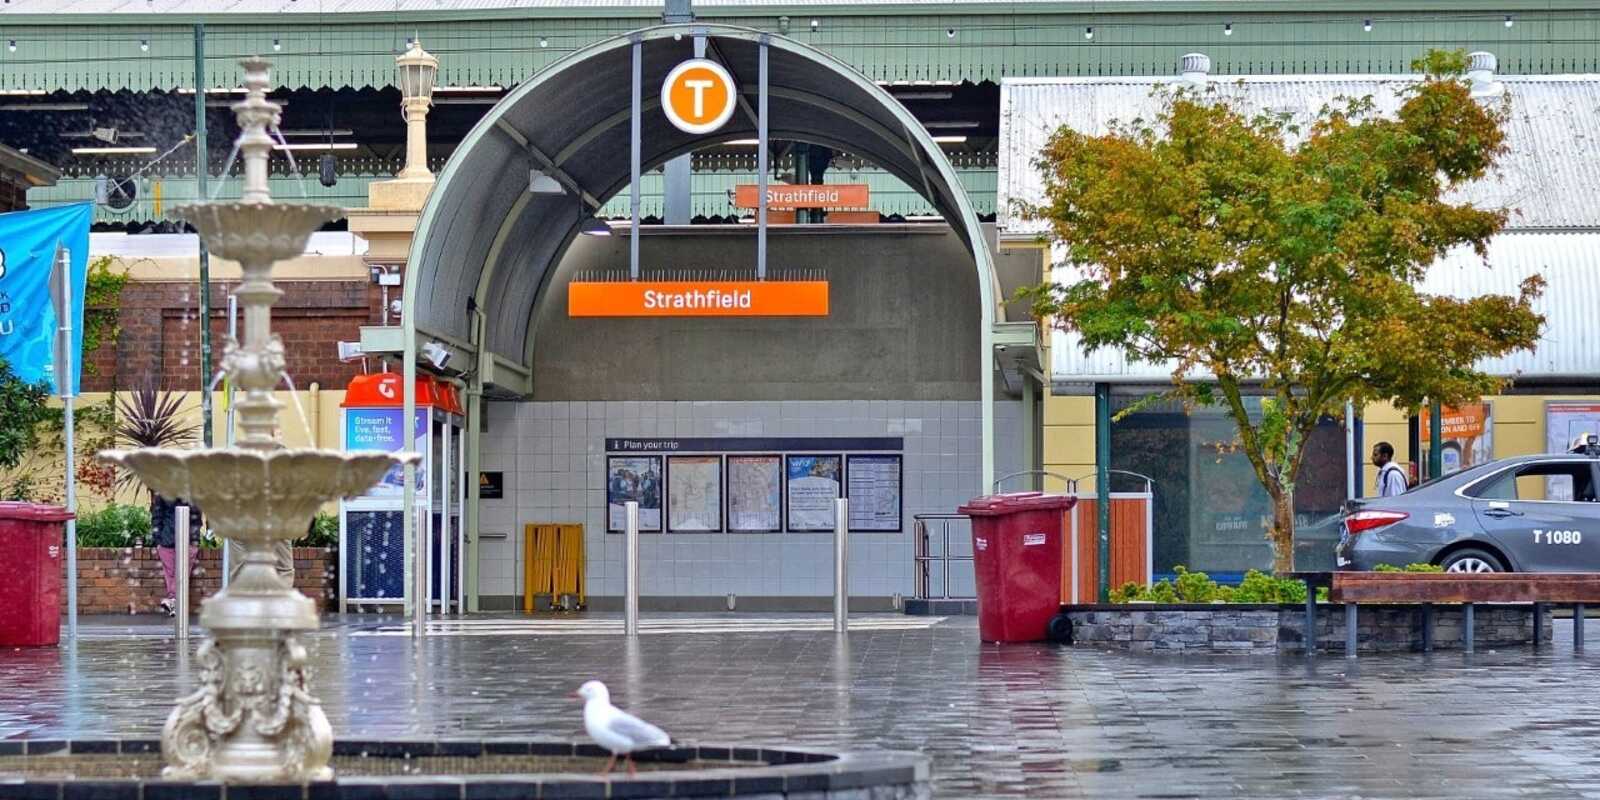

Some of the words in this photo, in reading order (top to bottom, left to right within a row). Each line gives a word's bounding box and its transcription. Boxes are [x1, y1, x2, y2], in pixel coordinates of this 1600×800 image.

[684, 79, 714, 118] T
[766, 189, 839, 203] Strathfield
[643, 289, 751, 309] Strathfield
[354, 416, 385, 425] Stream
[623, 440, 642, 449] Plan
[643, 442, 663, 450] your
[663, 440, 679, 450] trip
[1532, 529, 1543, 544] T
[1545, 530, 1582, 545] 1080
